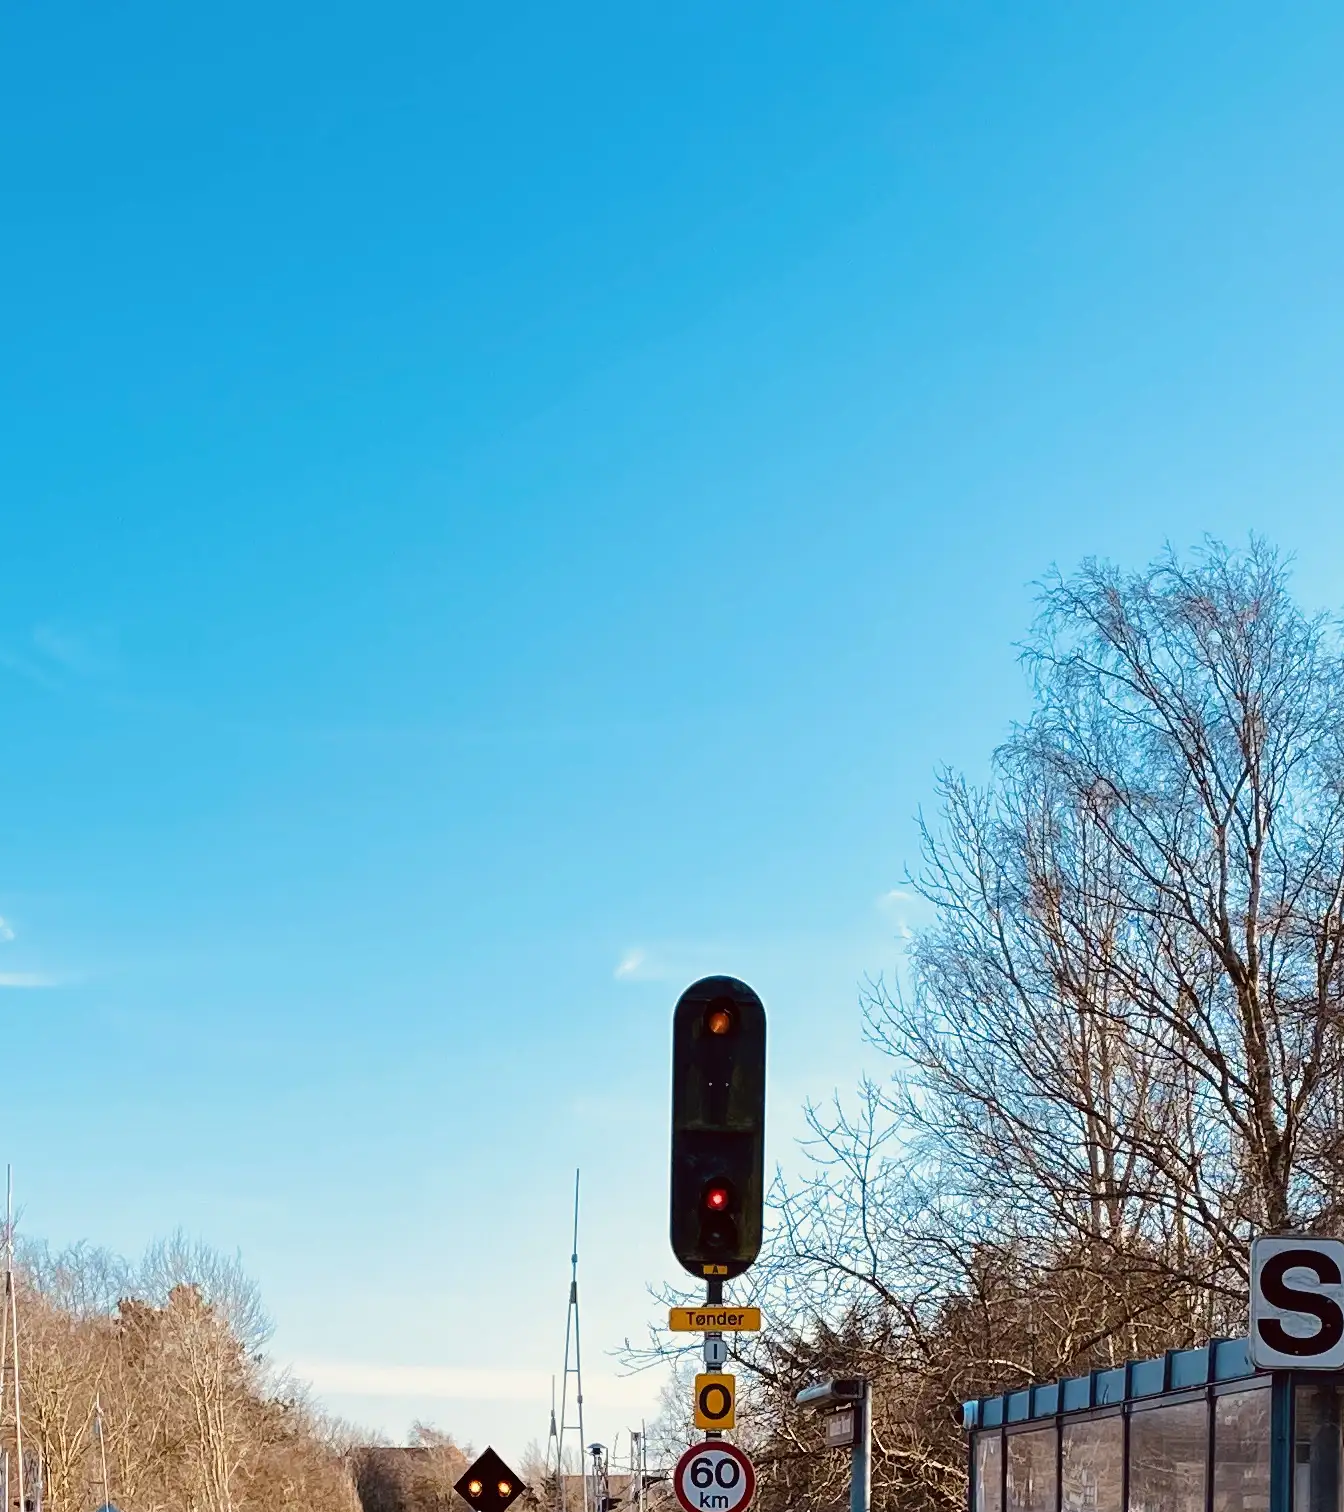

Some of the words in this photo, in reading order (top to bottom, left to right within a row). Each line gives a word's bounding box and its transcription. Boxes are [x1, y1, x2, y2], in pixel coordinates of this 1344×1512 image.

[1258, 1249, 1344, 1357] S
[685, 1311, 744, 1326] Tønder
[690, 1457, 740, 1489] 60
[699, 1491, 729, 1509] km
